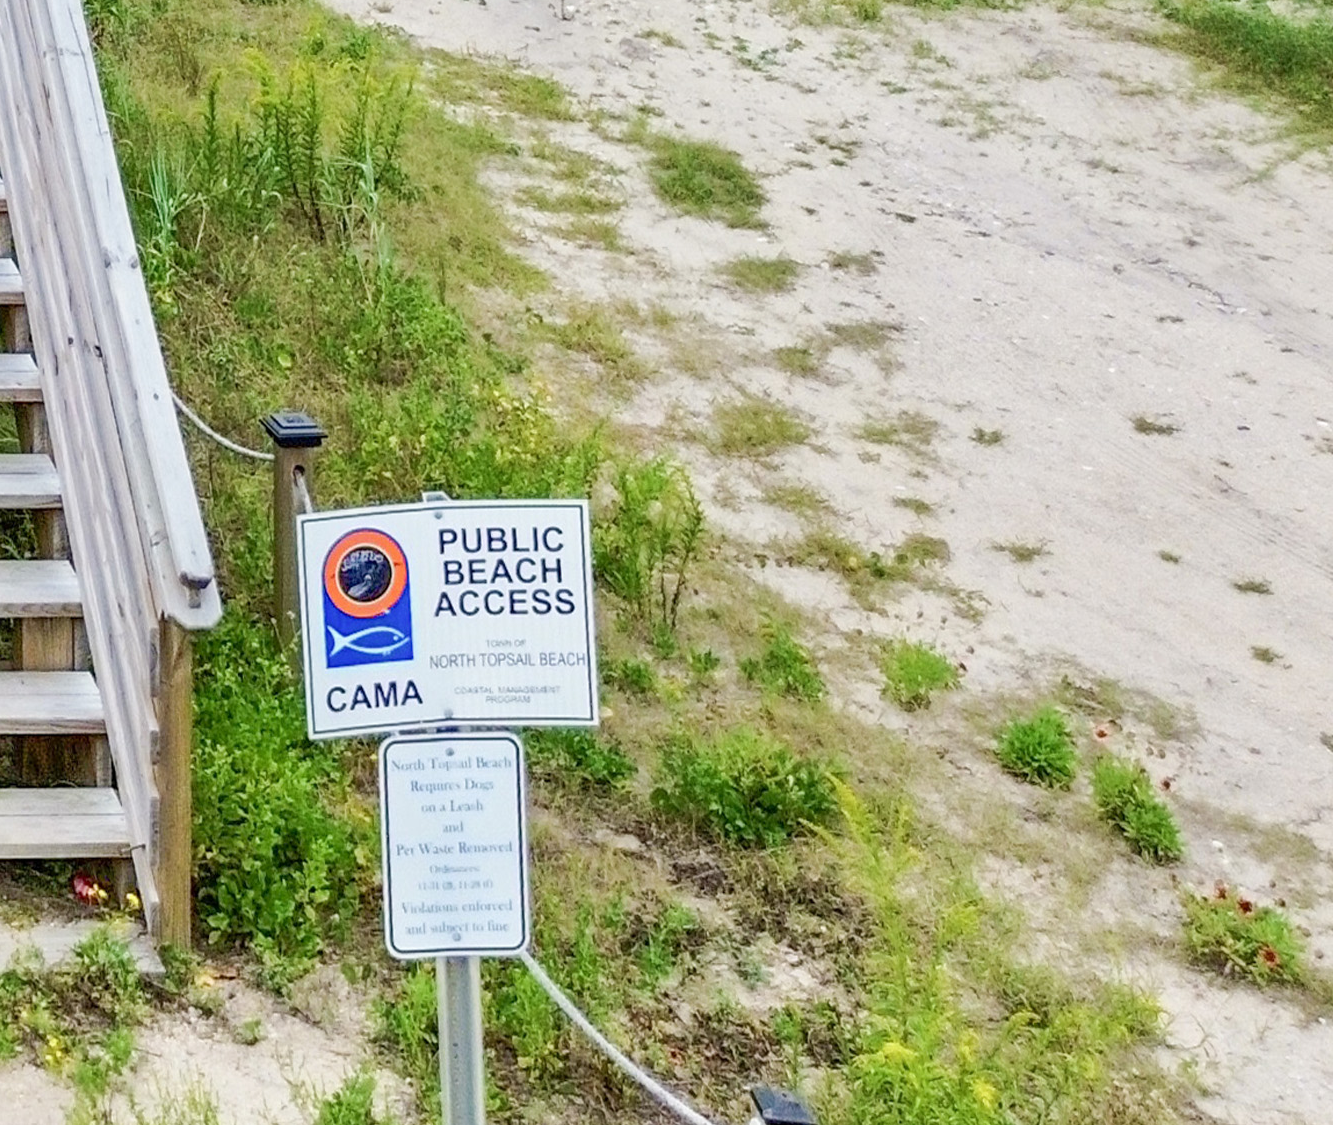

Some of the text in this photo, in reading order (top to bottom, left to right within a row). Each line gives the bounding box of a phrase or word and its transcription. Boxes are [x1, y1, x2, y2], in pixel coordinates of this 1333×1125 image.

[438, 527, 564, 555] PUBLIC
[443, 558, 562, 585] BEACH
[434, 589, 575, 617] ACCESS
[429, 653, 585, 669] NORTH TOPSAIL BEACH
[326, 680, 423, 713] CAMA
[454, 686, 561, 695] COASTAL MANAGEMENT
[485, 695, 531, 704] PROGRAM
[391, 756, 511, 771] North Topsail Beach
[410, 778, 494, 793] Requires Dogs
[450, 800, 483, 812] Leash
[443, 821, 464, 833] and
[418, 843, 453, 854] Waste
[458, 841, 512, 854] Removed
[402, 899, 513, 914] Violations enforced
[405, 922, 426, 935] and
[473, 922, 483, 932] to
[488, 920, 510, 932] fine
